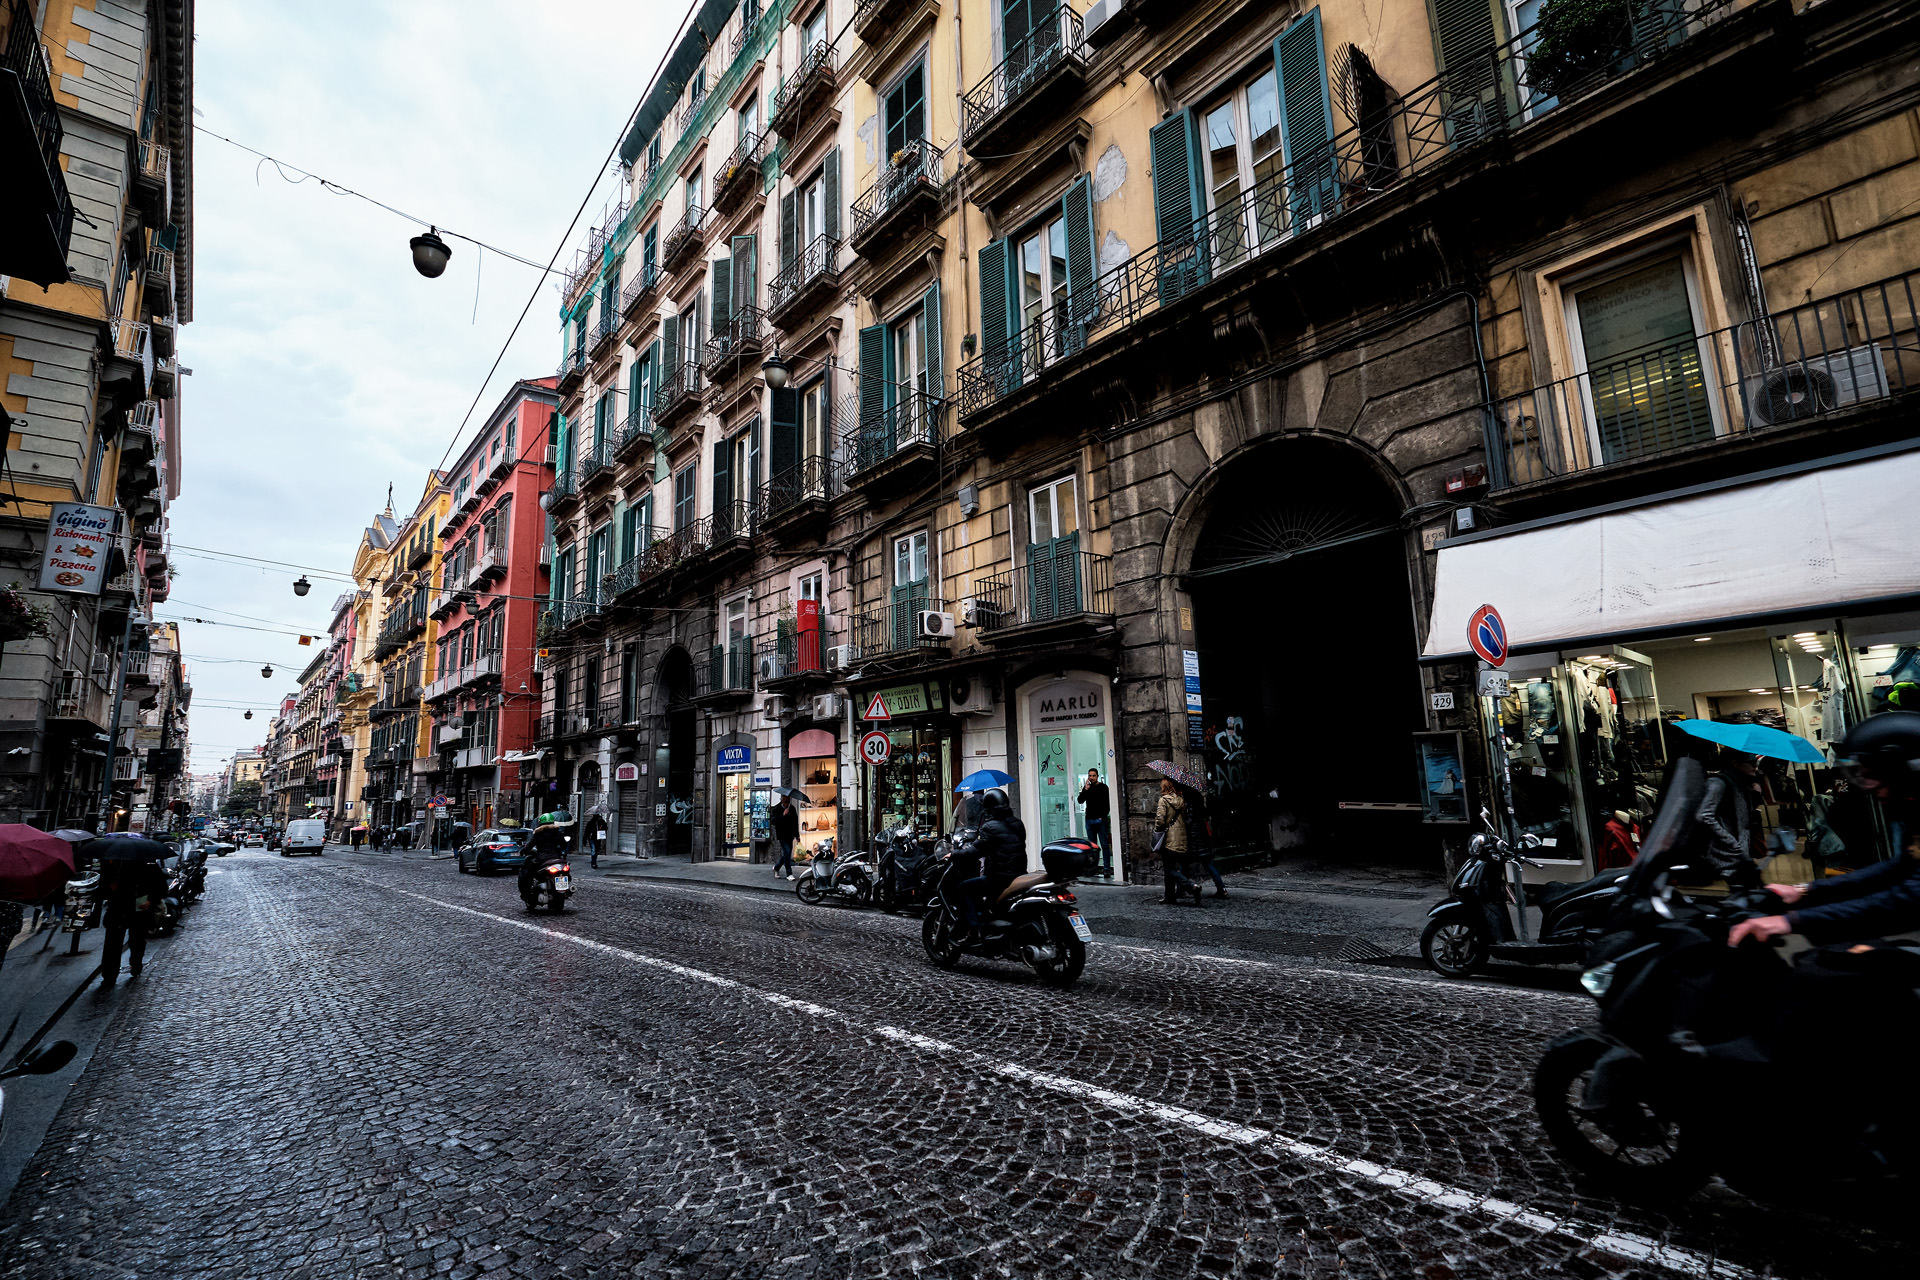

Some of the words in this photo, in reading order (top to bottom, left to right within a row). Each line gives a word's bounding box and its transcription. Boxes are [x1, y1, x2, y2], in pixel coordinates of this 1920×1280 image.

[75, 507, 87, 515] da
[57, 512, 106, 529] Gigino
[53, 528, 104, 543] Ristorante
[55, 545, 62, 553] &
[50, 558, 96, 571] Pizzeria
[1433, 697, 1452, 708] 429
[1078, 711, 1098, 719] TOLEDO
[867, 740, 885, 756] 30
